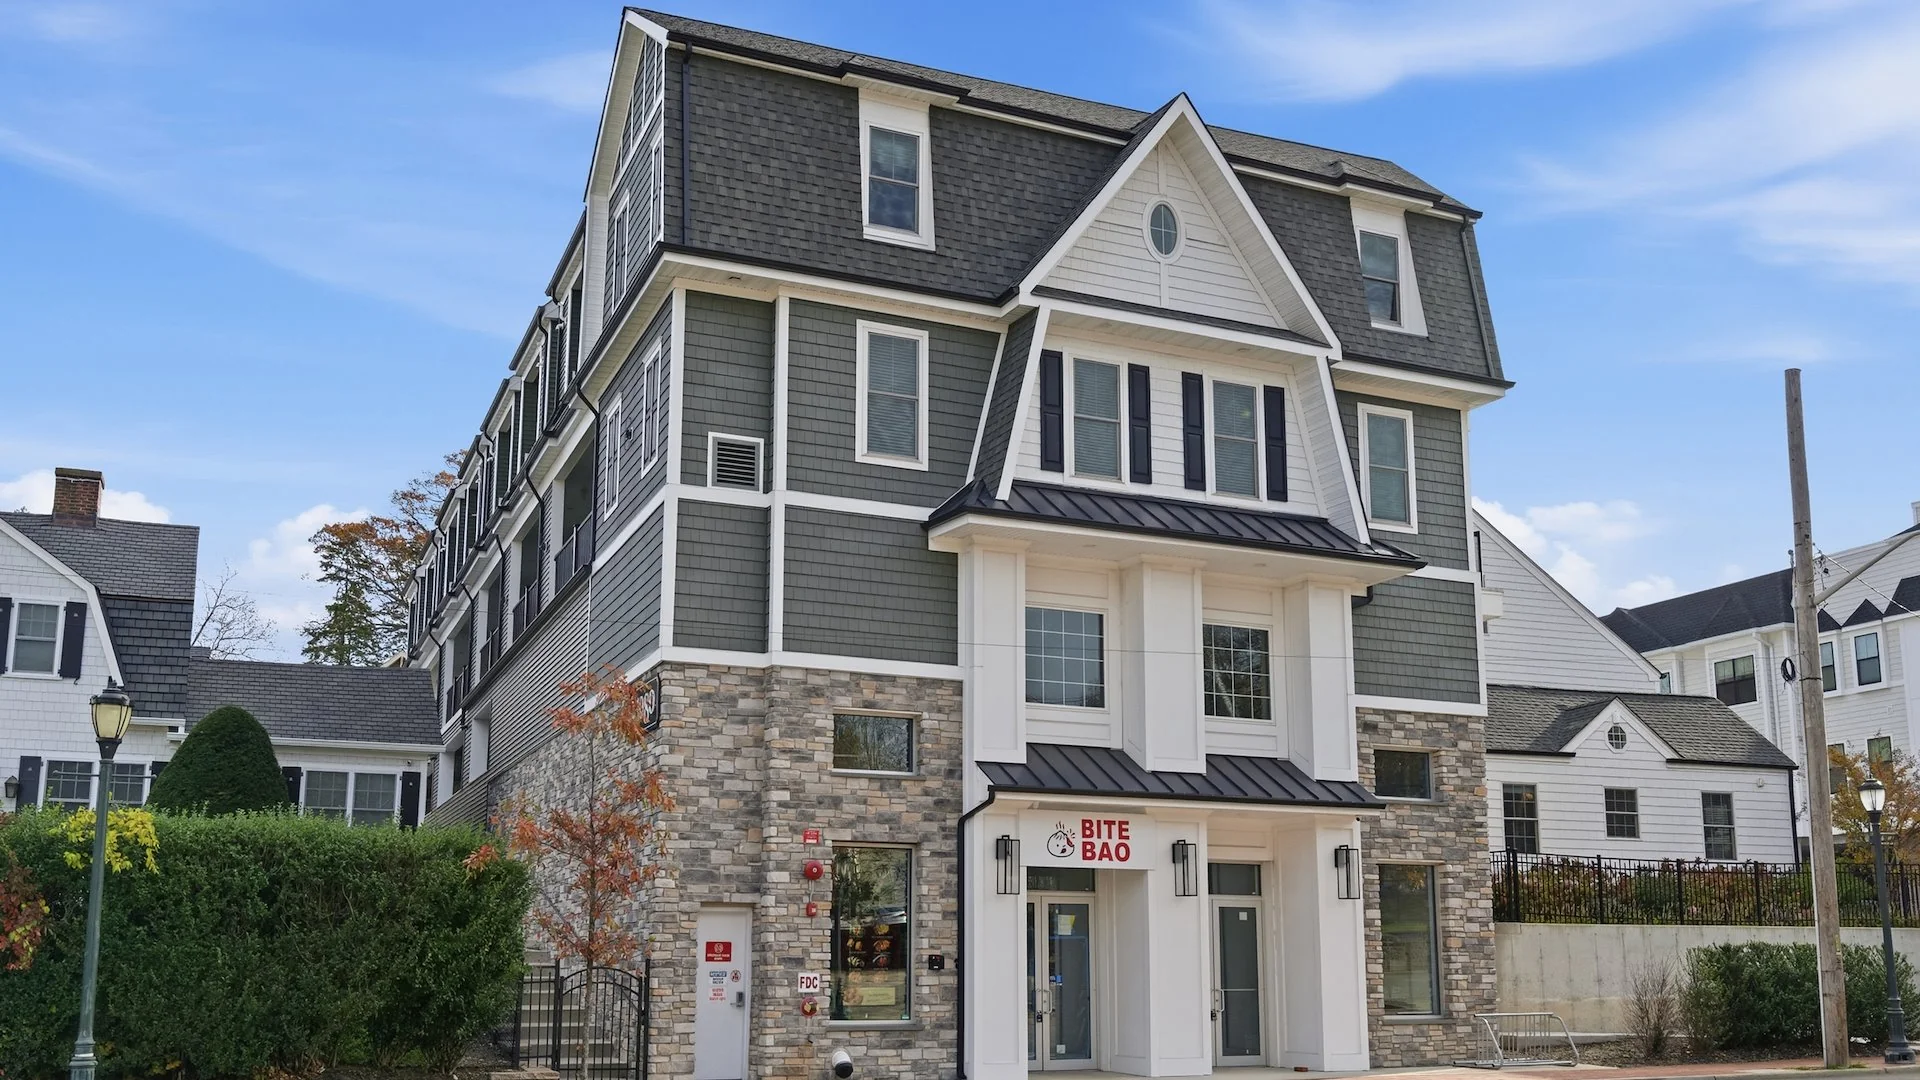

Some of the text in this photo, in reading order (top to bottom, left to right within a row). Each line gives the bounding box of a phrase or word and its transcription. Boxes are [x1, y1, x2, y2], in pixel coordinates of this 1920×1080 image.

[1081, 819, 1130, 840] BITE
[1082, 841, 1131, 862] BAO
[800, 976, 818, 989] FDC
